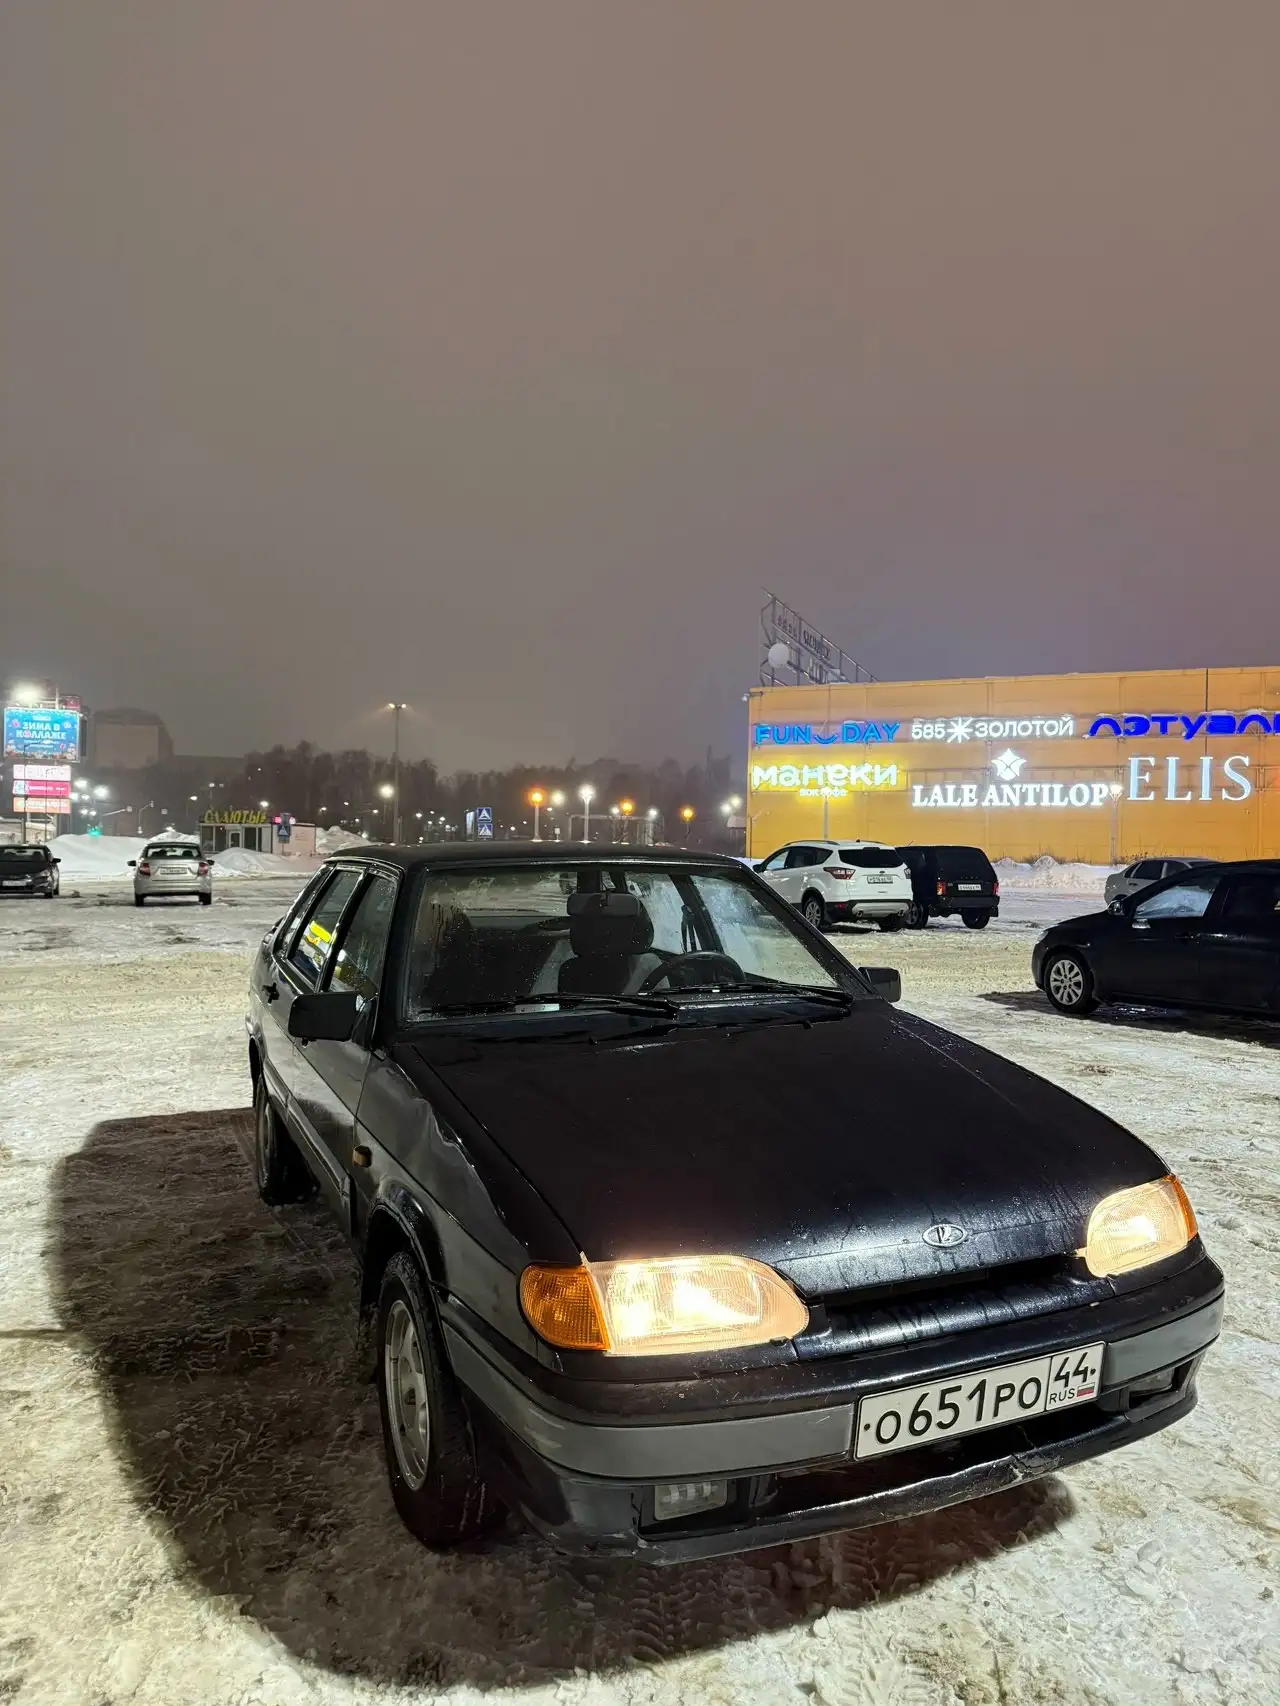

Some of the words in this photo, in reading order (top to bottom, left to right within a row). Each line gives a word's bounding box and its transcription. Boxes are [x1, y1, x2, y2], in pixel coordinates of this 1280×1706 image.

[16, 730, 66, 740] КОЛЛАЖЕ
[23, 721, 51, 730] ЗИМА
[54, 723, 61, 731] В
[755, 724, 811, 744] FUN
[841, 722, 900, 742] DAY
[911, 723, 945, 739] 585
[975, 713, 1075, 738] ЗОЛОТОЙ
[1127, 755, 1251, 801] ELIS
[911, 784, 978, 808] LALE
[875, 1376, 1042, 1445] О651РО
[1053, 1351, 1090, 1389] 44
[1049, 1387, 1076, 1405] RUS
